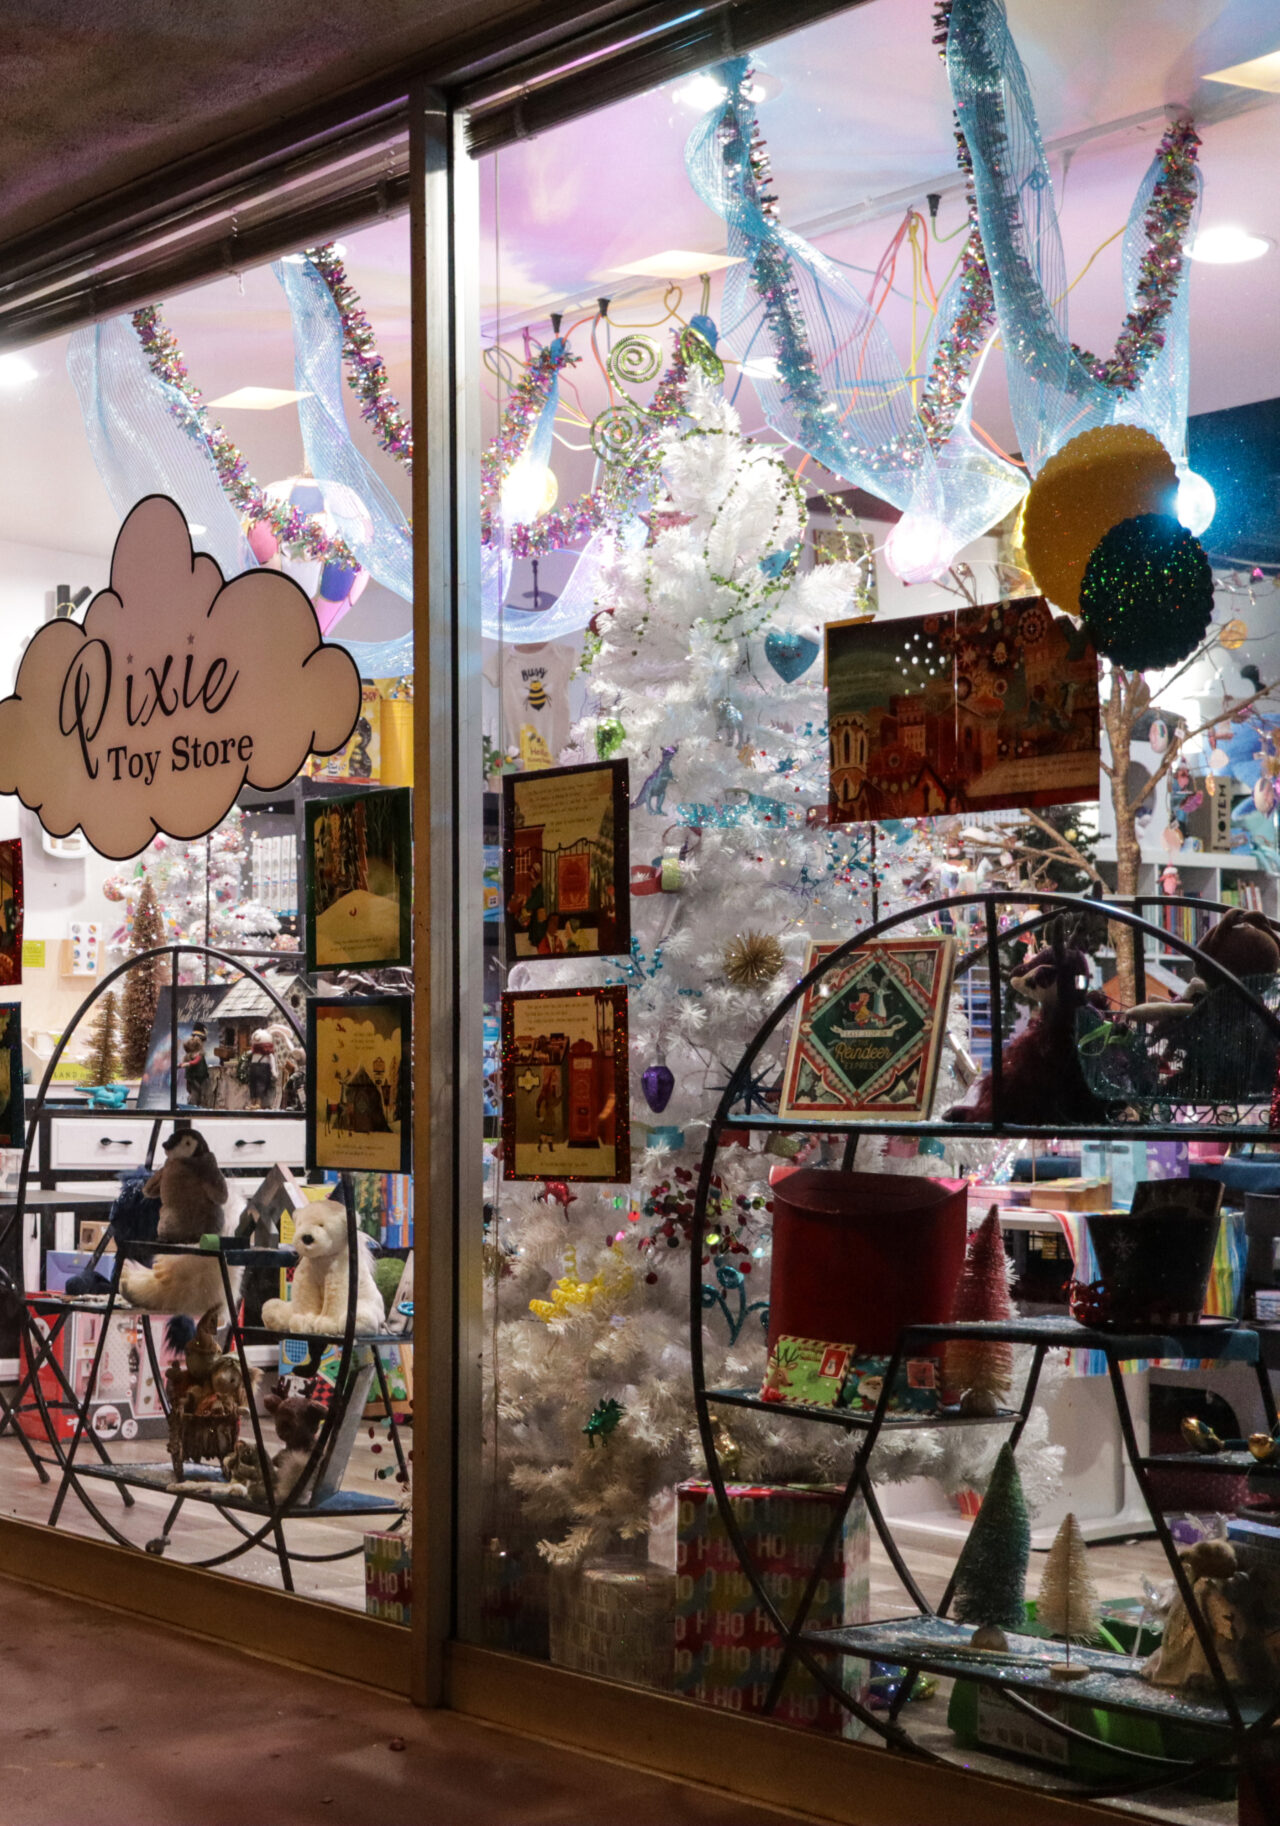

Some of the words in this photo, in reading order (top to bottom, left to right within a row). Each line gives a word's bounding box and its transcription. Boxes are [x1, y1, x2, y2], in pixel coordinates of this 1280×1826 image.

[58, 634, 240, 780] Pixie
[107, 746, 161, 786] Toy
[171, 734, 254, 772] Store
[1218, 783, 1227, 842] TOTEM
[835, 1041, 892, 1063] Reindeer
[716, 1611, 744, 1637] HO
